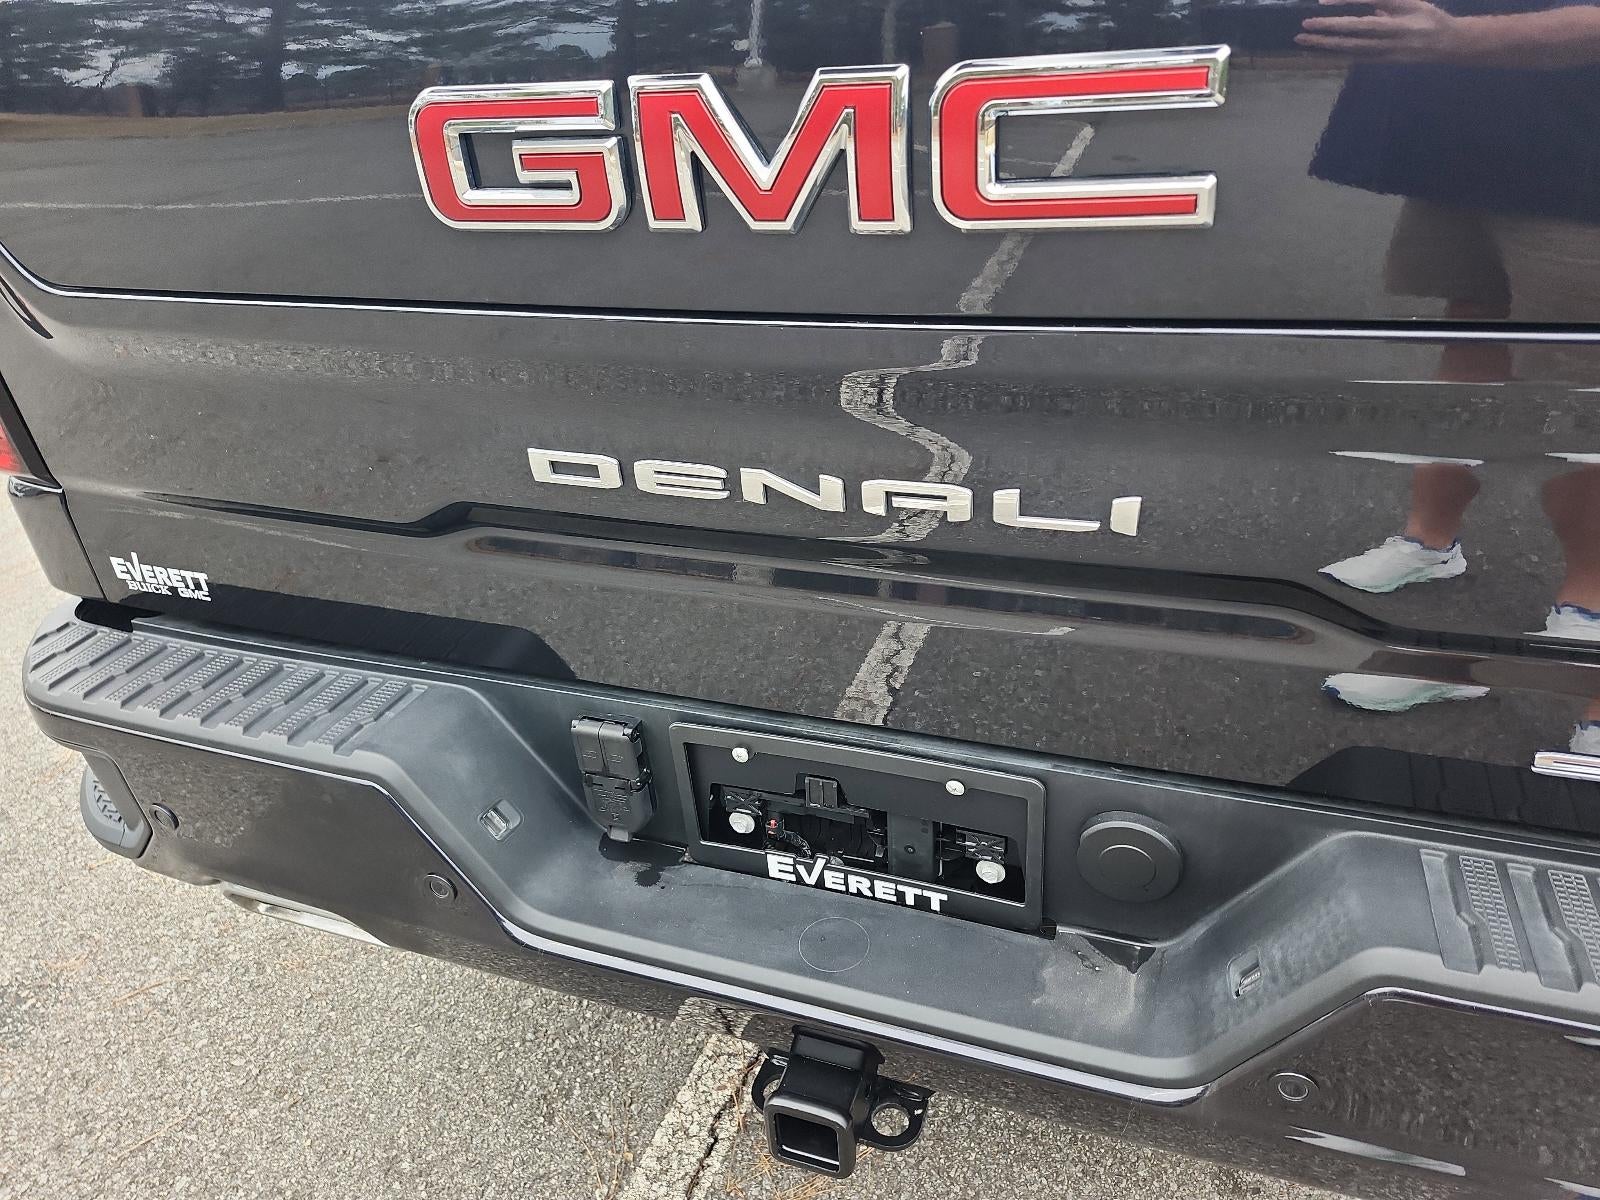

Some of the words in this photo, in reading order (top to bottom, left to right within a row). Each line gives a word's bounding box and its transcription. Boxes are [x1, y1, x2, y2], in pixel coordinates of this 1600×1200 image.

[409, 44, 1231, 234] GMC
[527, 447, 1142, 536] DENALI
[110, 551, 209, 591] EVERETT
[126, 580, 172, 595] BUICK
[178, 587, 211, 602] GMC
[766, 853, 948, 912] EVERETT
